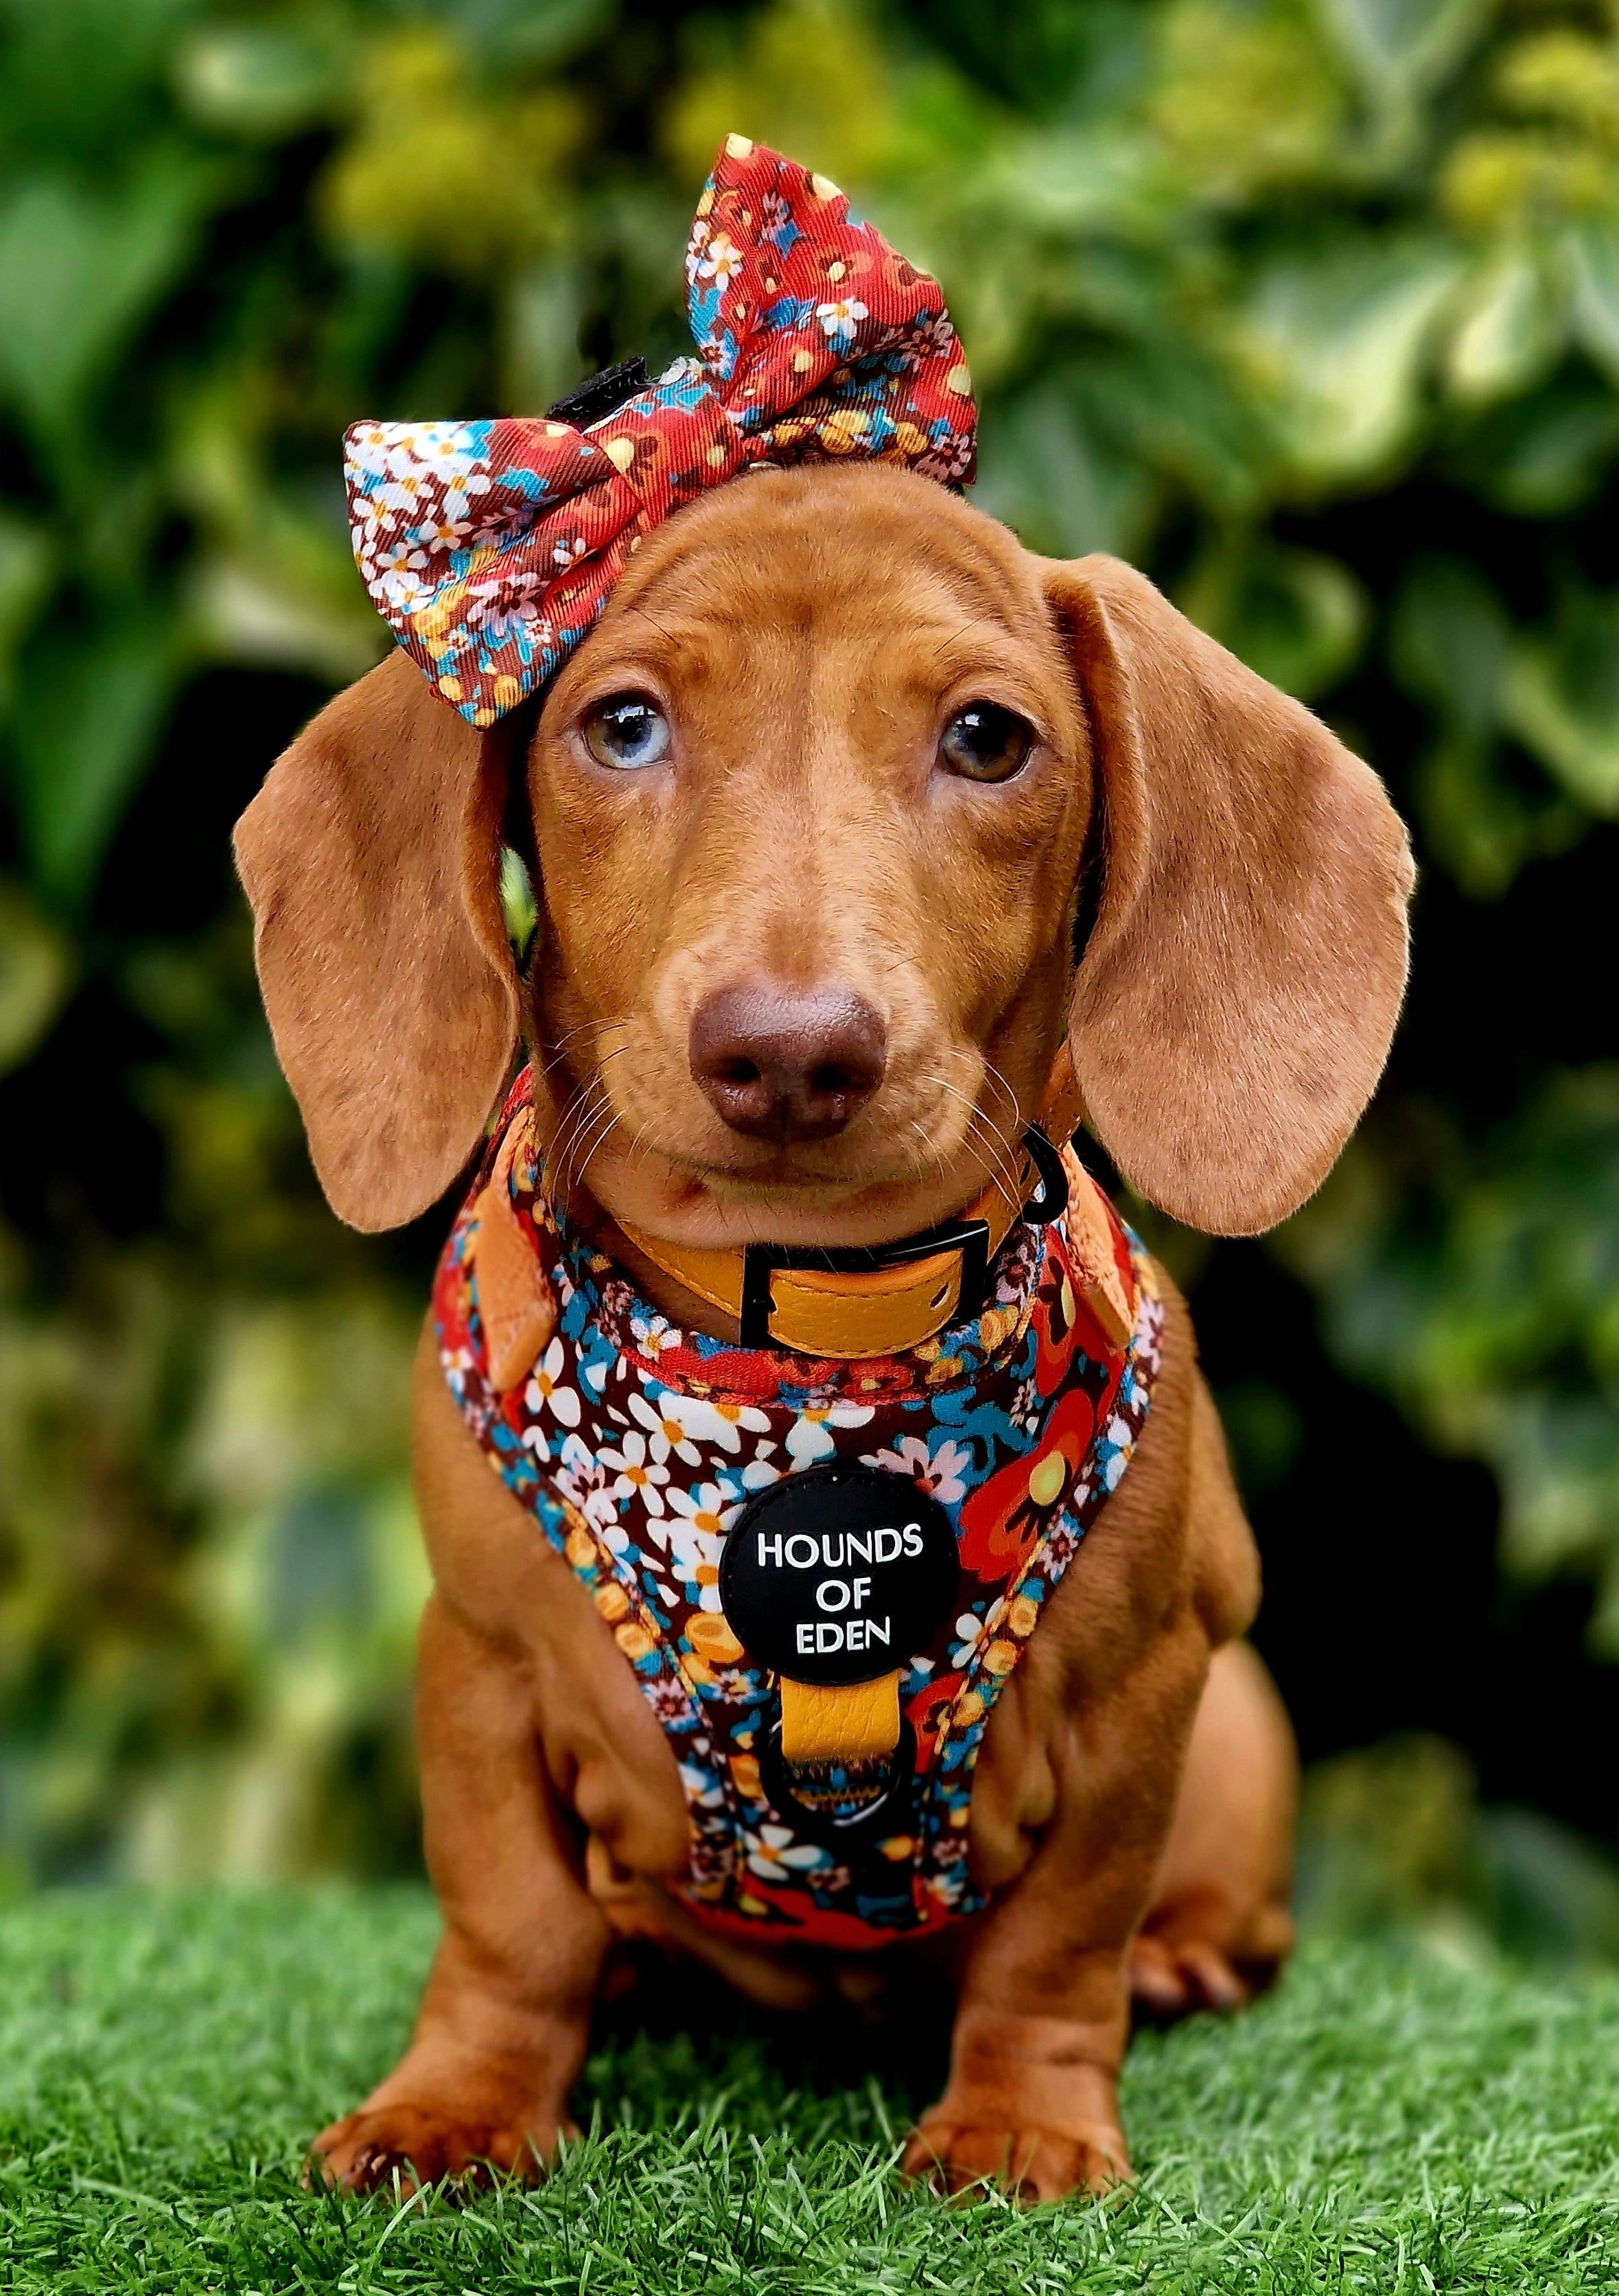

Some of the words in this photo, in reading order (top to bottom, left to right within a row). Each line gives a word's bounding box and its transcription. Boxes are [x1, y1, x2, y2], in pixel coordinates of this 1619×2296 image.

[758, 1523, 924, 1569] HOUNDS
[815, 1577, 872, 1612] OF
[796, 1616, 890, 1654] EDEN
